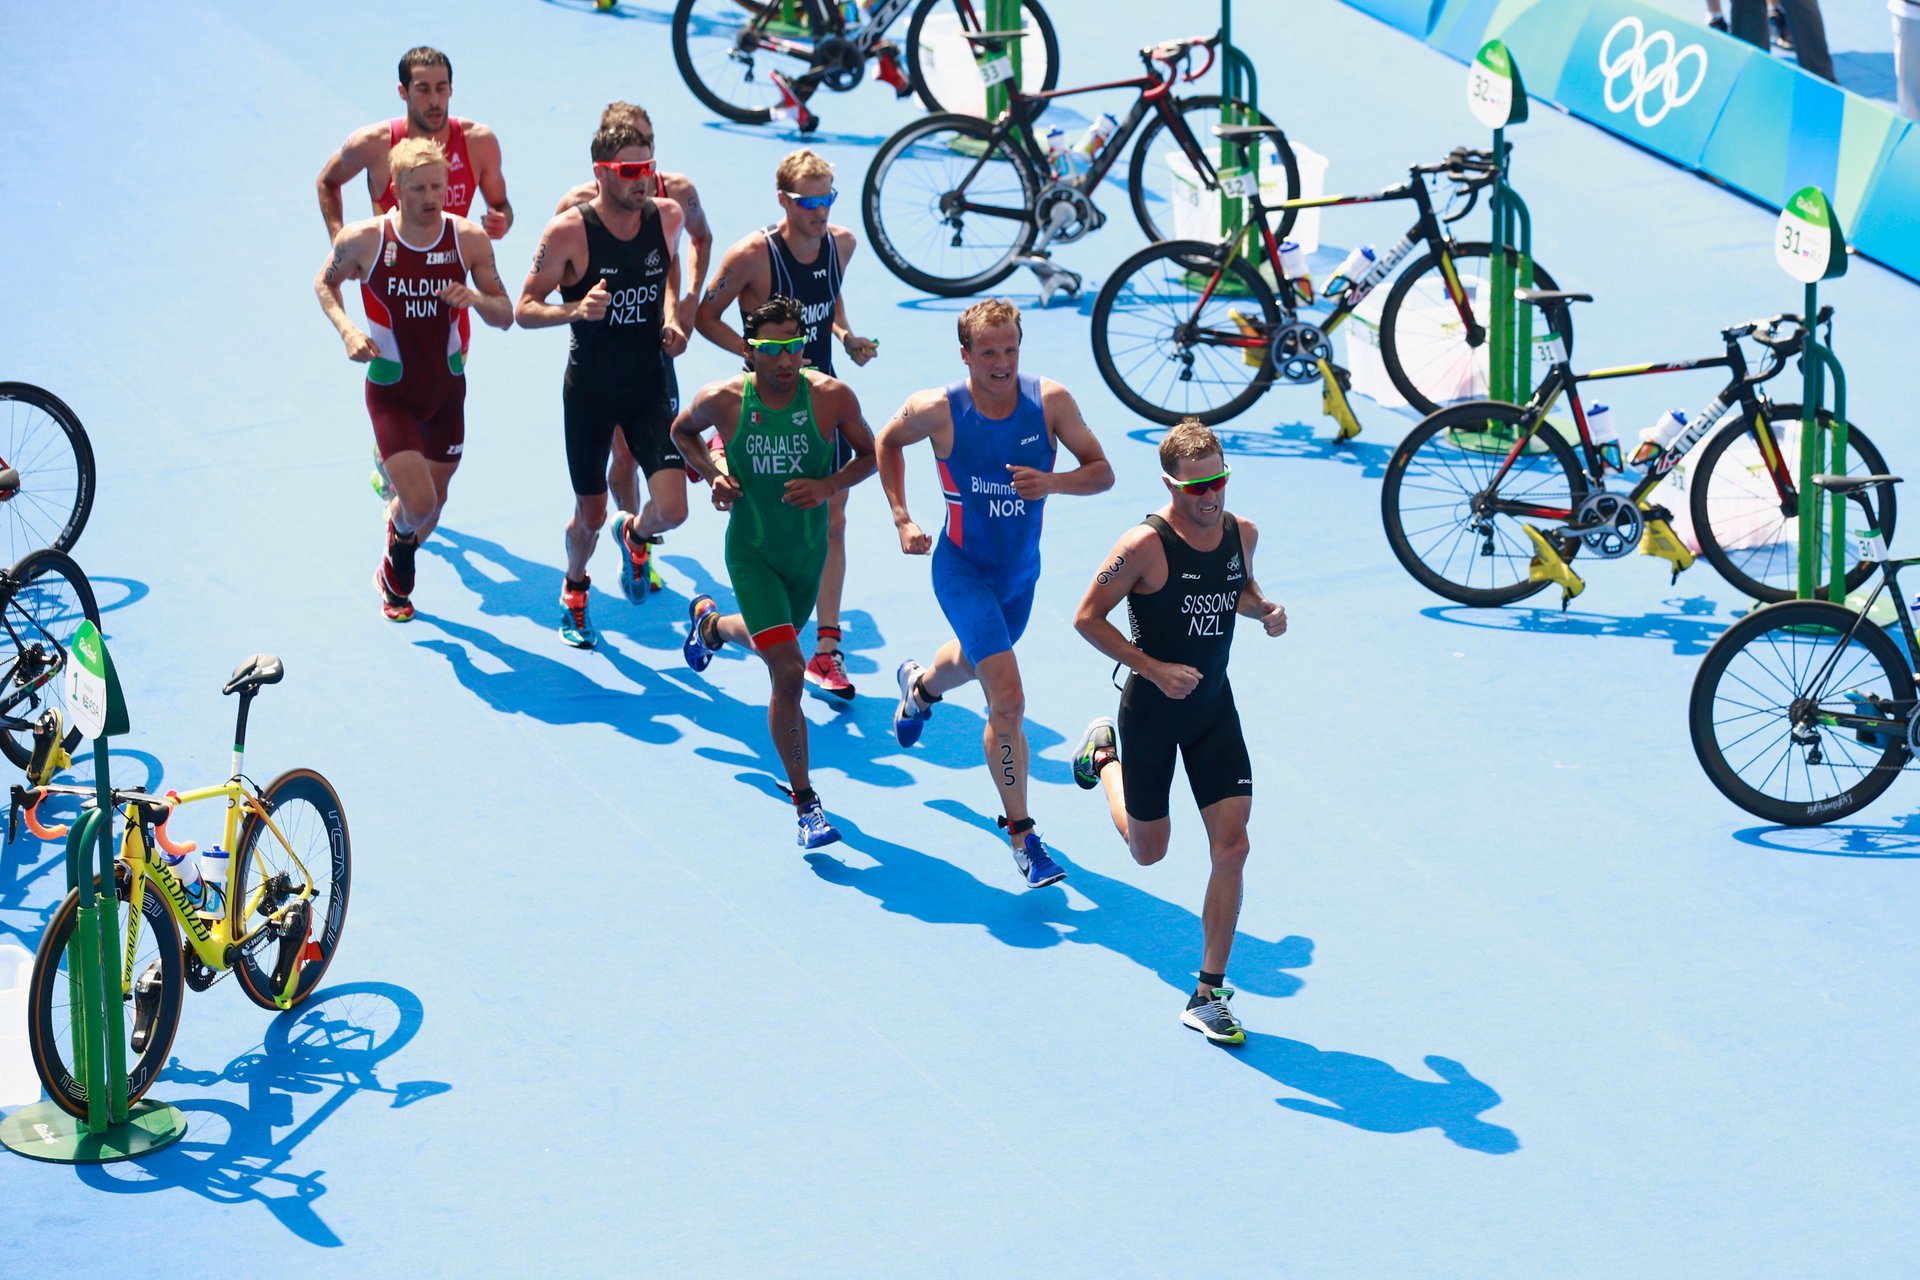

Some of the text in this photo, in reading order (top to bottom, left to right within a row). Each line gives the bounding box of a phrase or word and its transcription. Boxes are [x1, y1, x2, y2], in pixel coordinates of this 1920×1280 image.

[1473, 75, 1489, 102] 32
[1224, 180, 1245, 195] 32
[1782, 225, 1801, 255] 31
[813, 268, 827, 280] TYR
[405, 300, 438, 318] HUN
[609, 305, 647, 327] NZL
[1537, 345, 1554, 361] 31
[745, 433, 809, 456] GRAJALES
[1020, 434, 1040, 446] 2XU
[752, 455, 804, 474] MEX
[971, 476, 1018, 496] Blumme
[989, 500, 1026, 518] NOR
[1096, 555, 1126, 586] 36
[1181, 590, 1237, 614] SISSONS
[1188, 615, 1224, 636] NZL
[1000, 744, 1016, 787] 25
[152, 857, 211, 942] SPECIALIZED
[125, 904, 138, 983] SPECIALIZED
